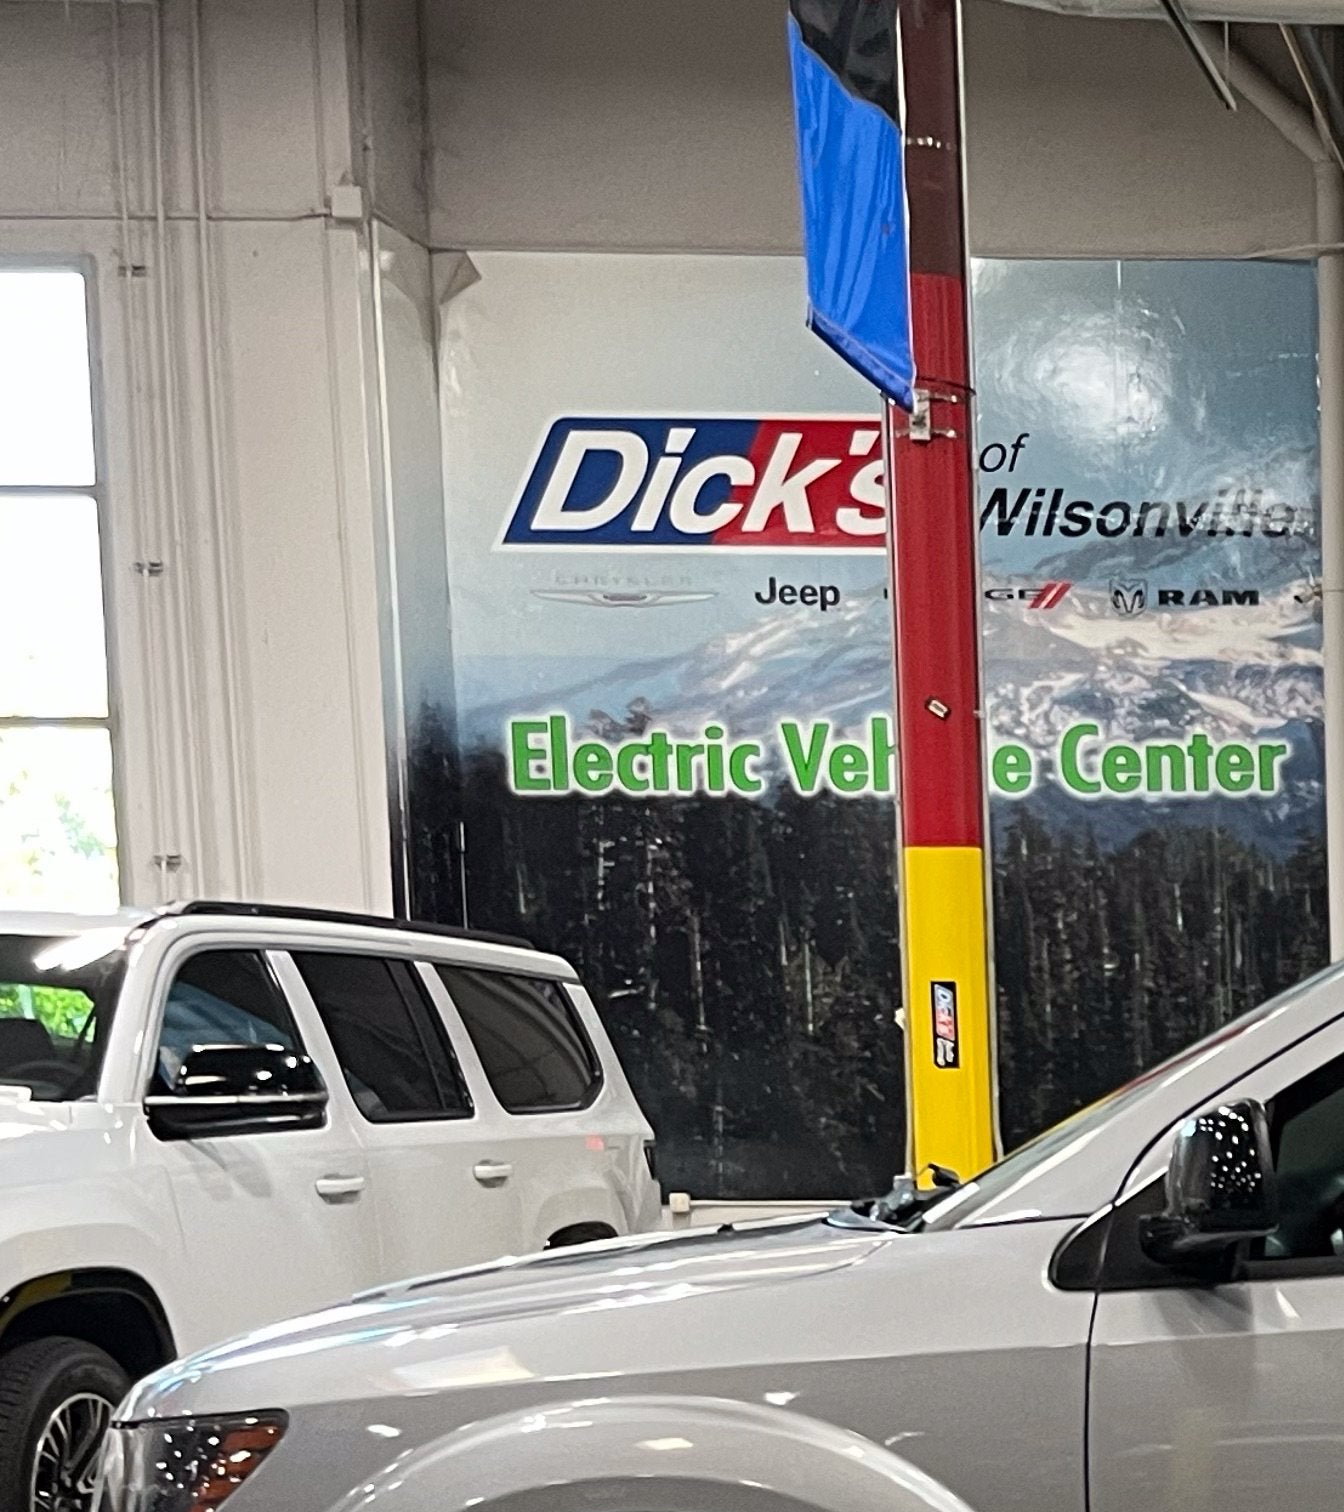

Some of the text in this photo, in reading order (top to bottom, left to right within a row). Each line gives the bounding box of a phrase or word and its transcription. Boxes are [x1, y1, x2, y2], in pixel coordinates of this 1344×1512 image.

[979, 433, 1030, 473] of
[530, 427, 887, 536] Dick's
[755, 577, 840, 611] Jeep
[1158, 589, 1260, 606] RAM
[511, 715, 1287, 793] Electric Vehe Center
